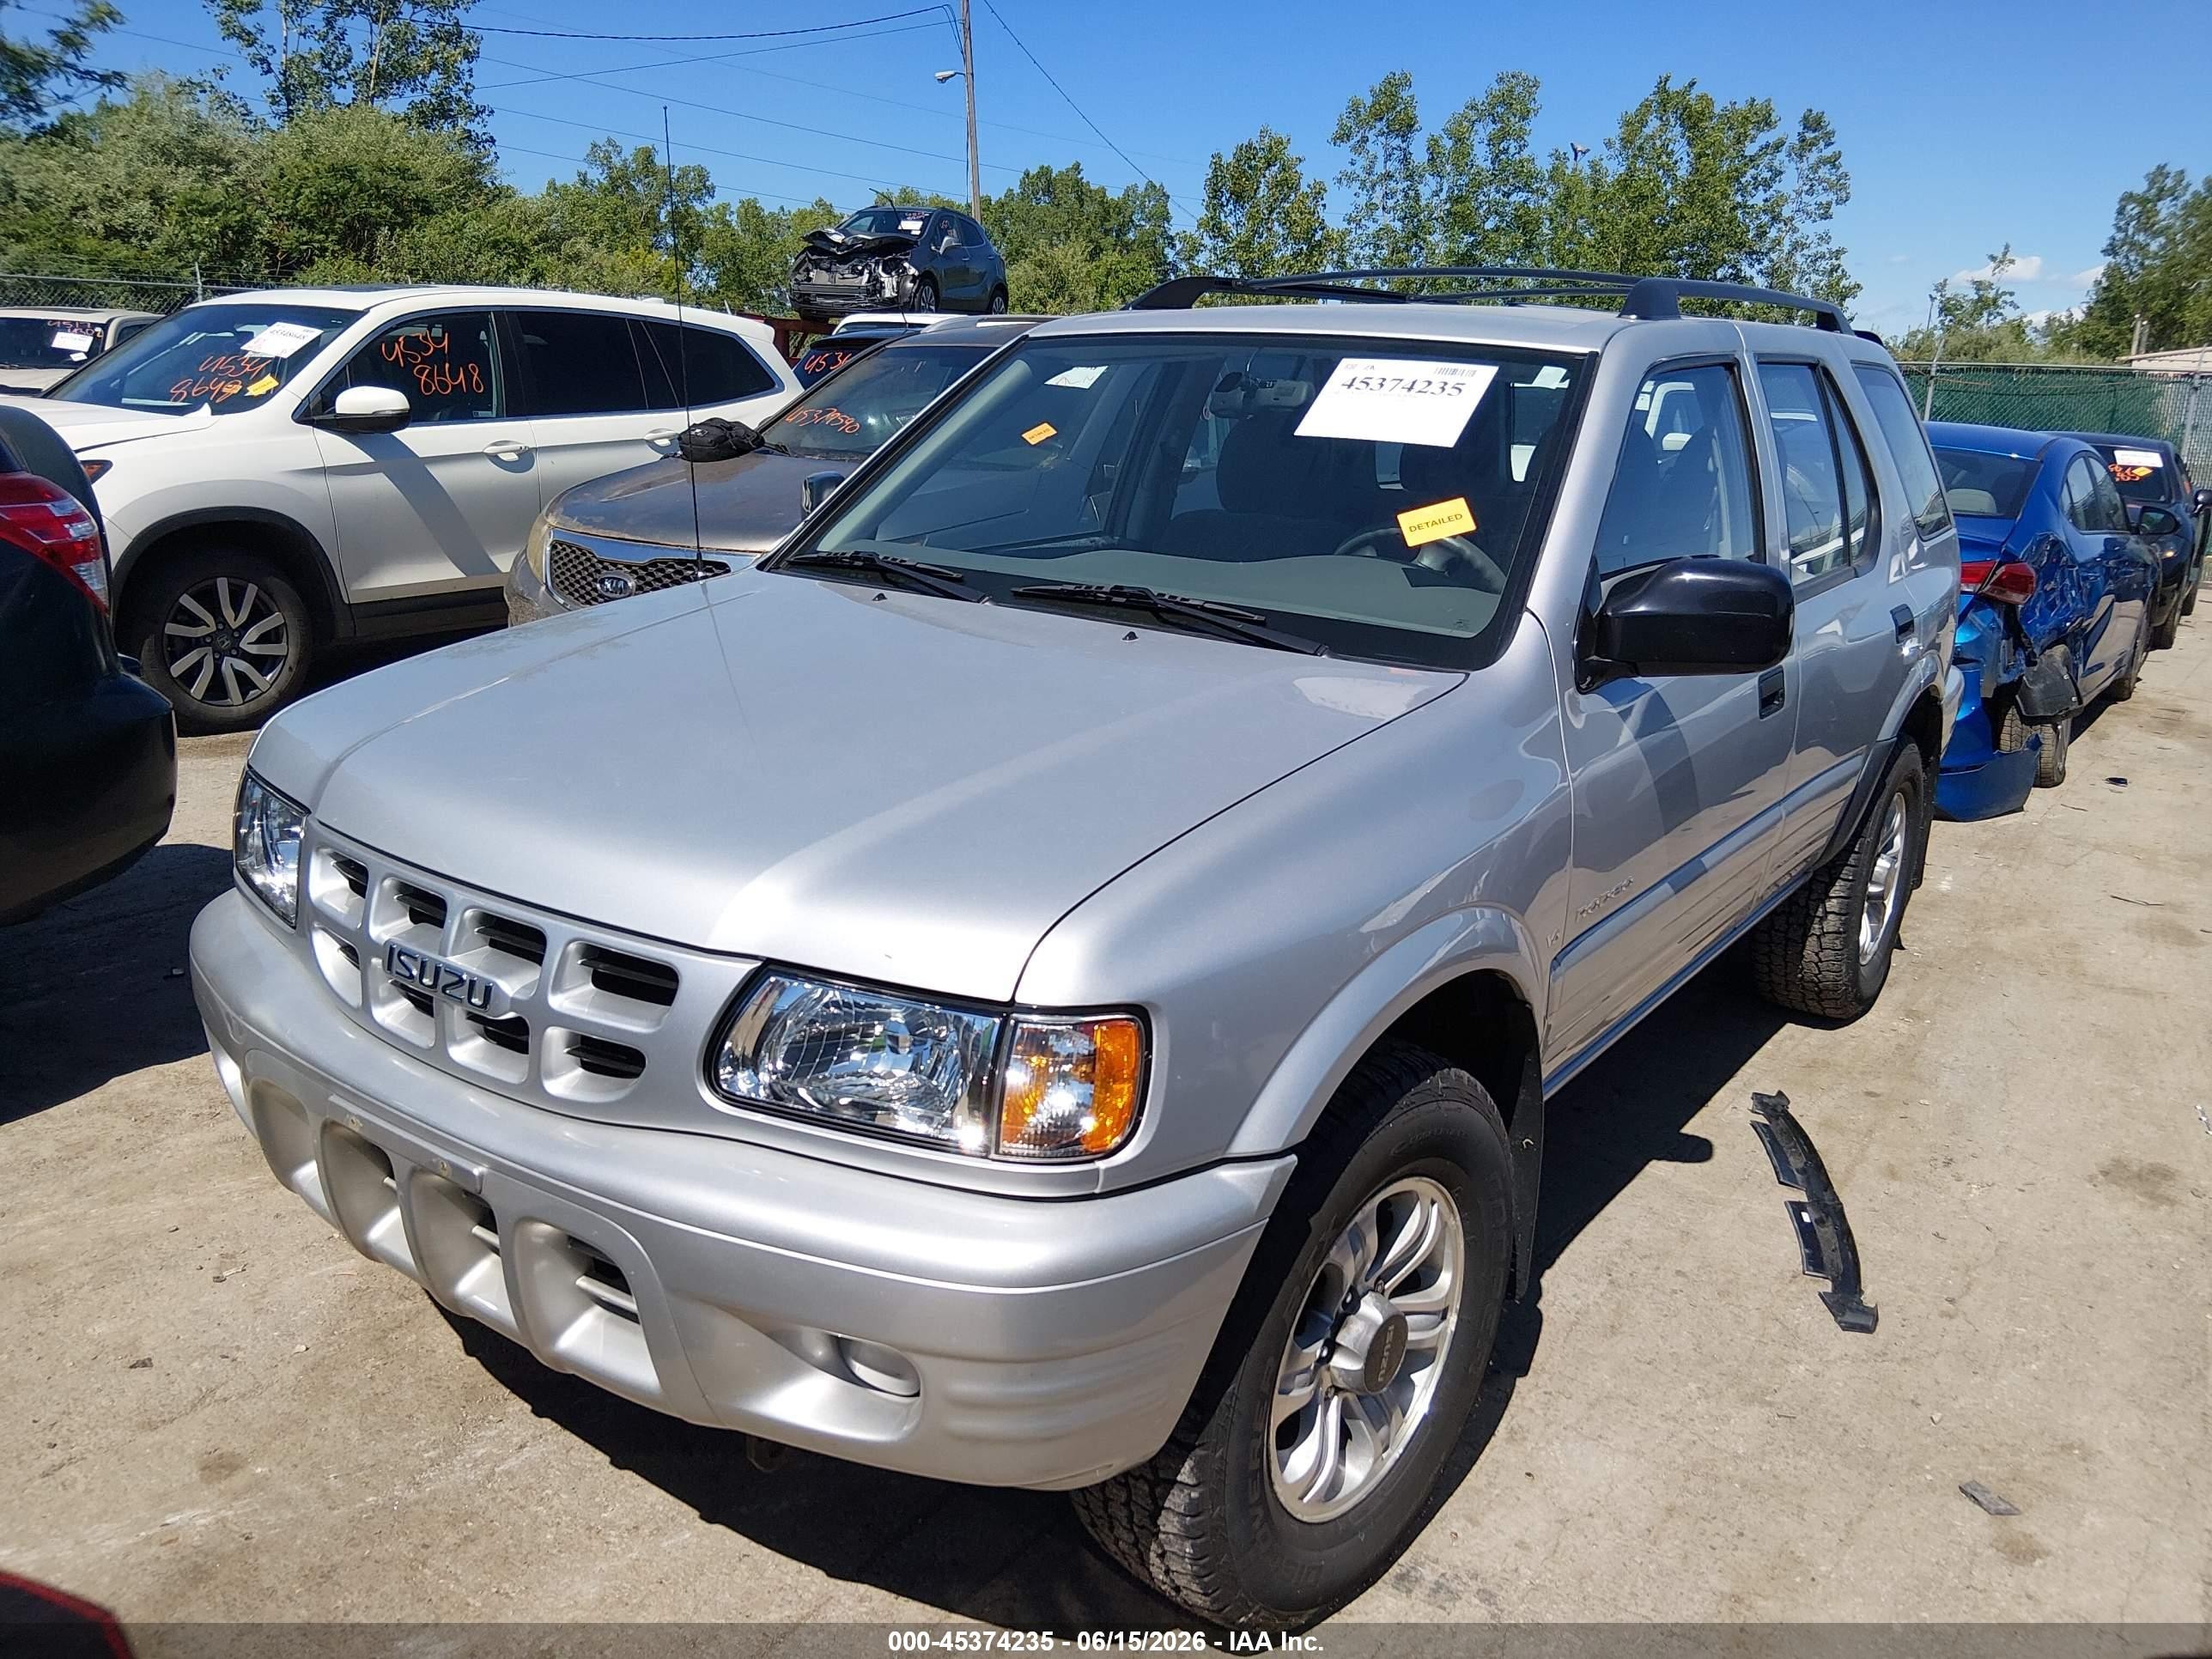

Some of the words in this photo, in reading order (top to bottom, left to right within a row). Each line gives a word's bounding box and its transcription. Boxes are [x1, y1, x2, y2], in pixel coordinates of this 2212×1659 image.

[381, 329, 448, 368] 4534
[198, 355, 272, 380] 4534
[412, 362, 484, 395] 8648
[169, 376, 244, 404] 8648
[1340, 375, 1467, 397] 45374235
[1408, 514, 1463, 532] DETAILED
[387, 944, 494, 1011] ISUZU
[1377, 1324, 1395, 1382] ISUZU
